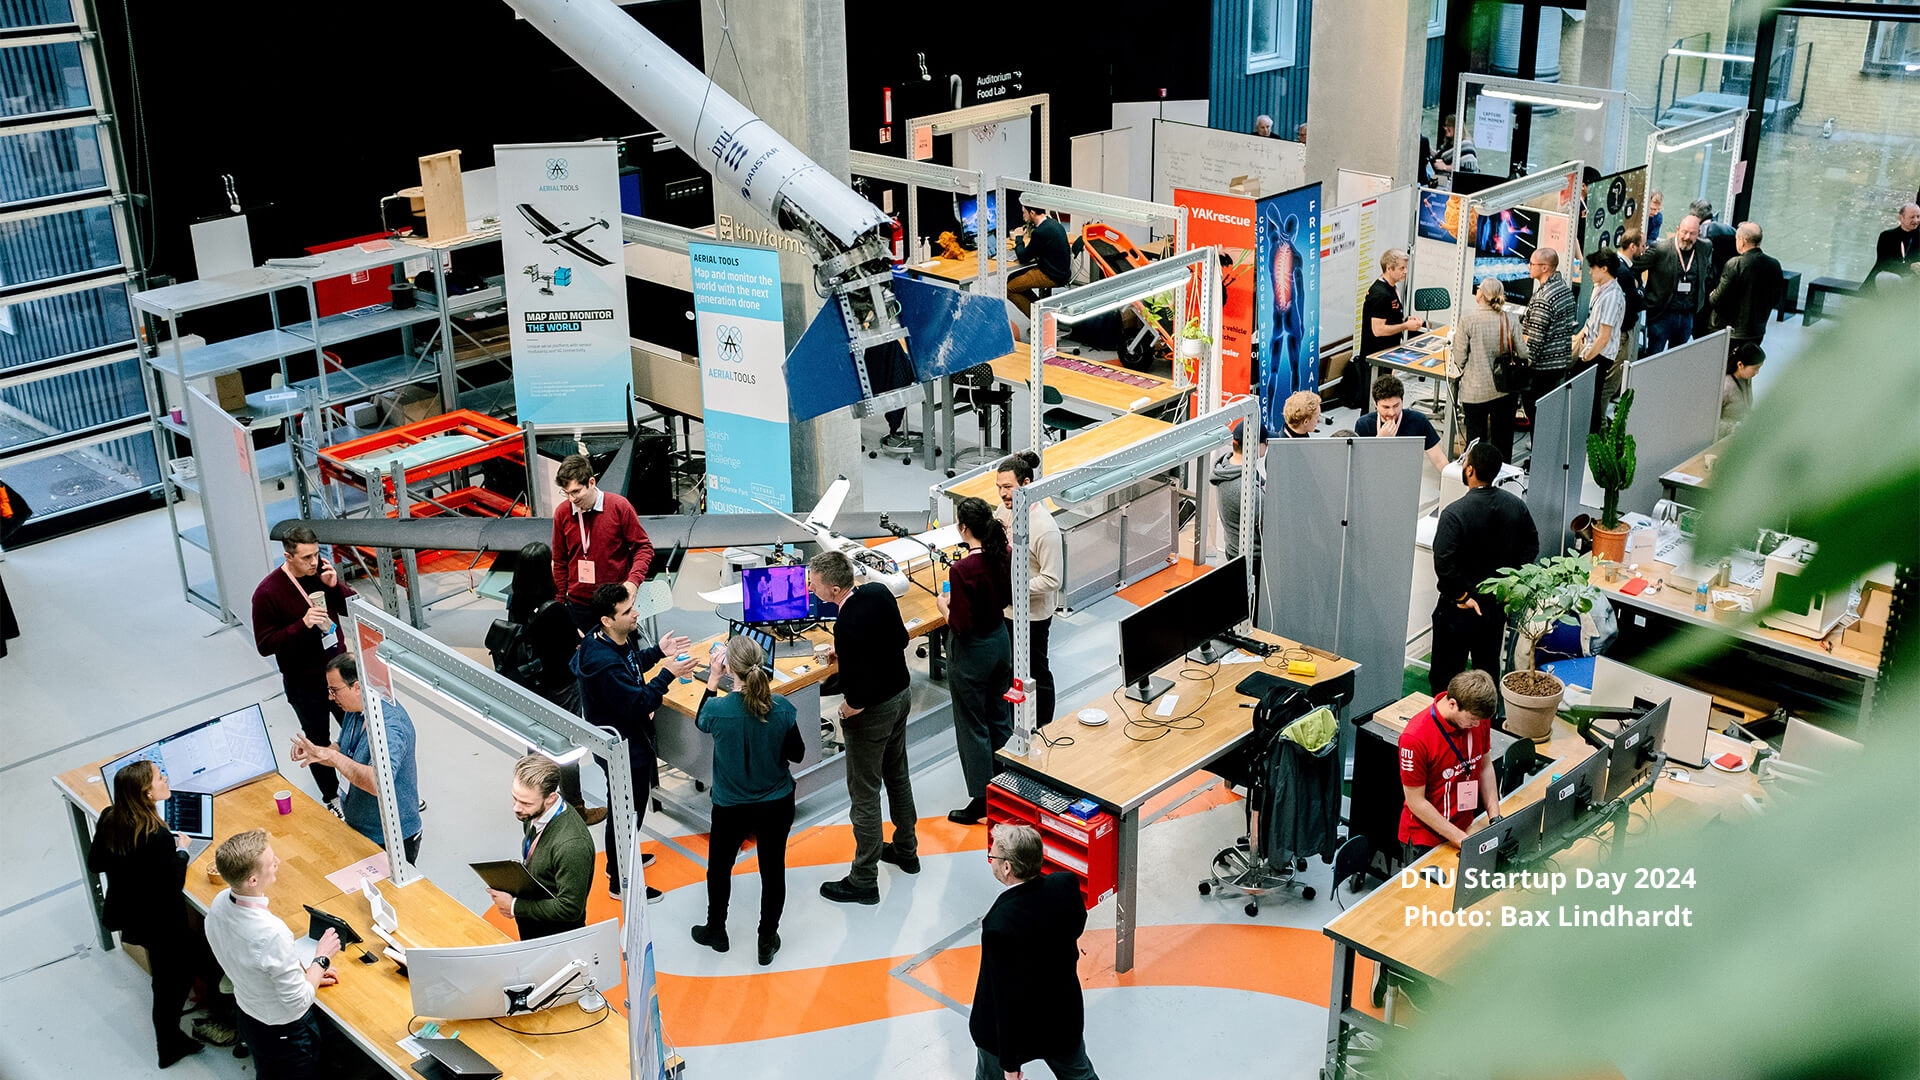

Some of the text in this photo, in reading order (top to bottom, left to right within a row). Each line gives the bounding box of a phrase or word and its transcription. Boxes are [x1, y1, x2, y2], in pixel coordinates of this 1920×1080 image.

[976, 72, 1012, 86] Auditorium
[976, 85, 1006, 99] Food Lab
[712, 130, 732, 159] DTU
[744, 146, 780, 187] DANSTAR
[1191, 207, 1251, 227] YAKrescue
[694, 254, 739, 266] AERIAL TOOLS
[695, 267, 773, 286] Map and monitor the
[696, 281, 768, 298] world with the next
[697, 294, 760, 310] generation drone
[548, 312, 568, 320] AND
[570, 311, 612, 320] MONITOR
[547, 323, 580, 331] WORLD
[1226, 326, 1247, 335] vehicle
[709, 368, 756, 384] AERIALTOOLS
[1401, 747, 1413, 759] DTU
